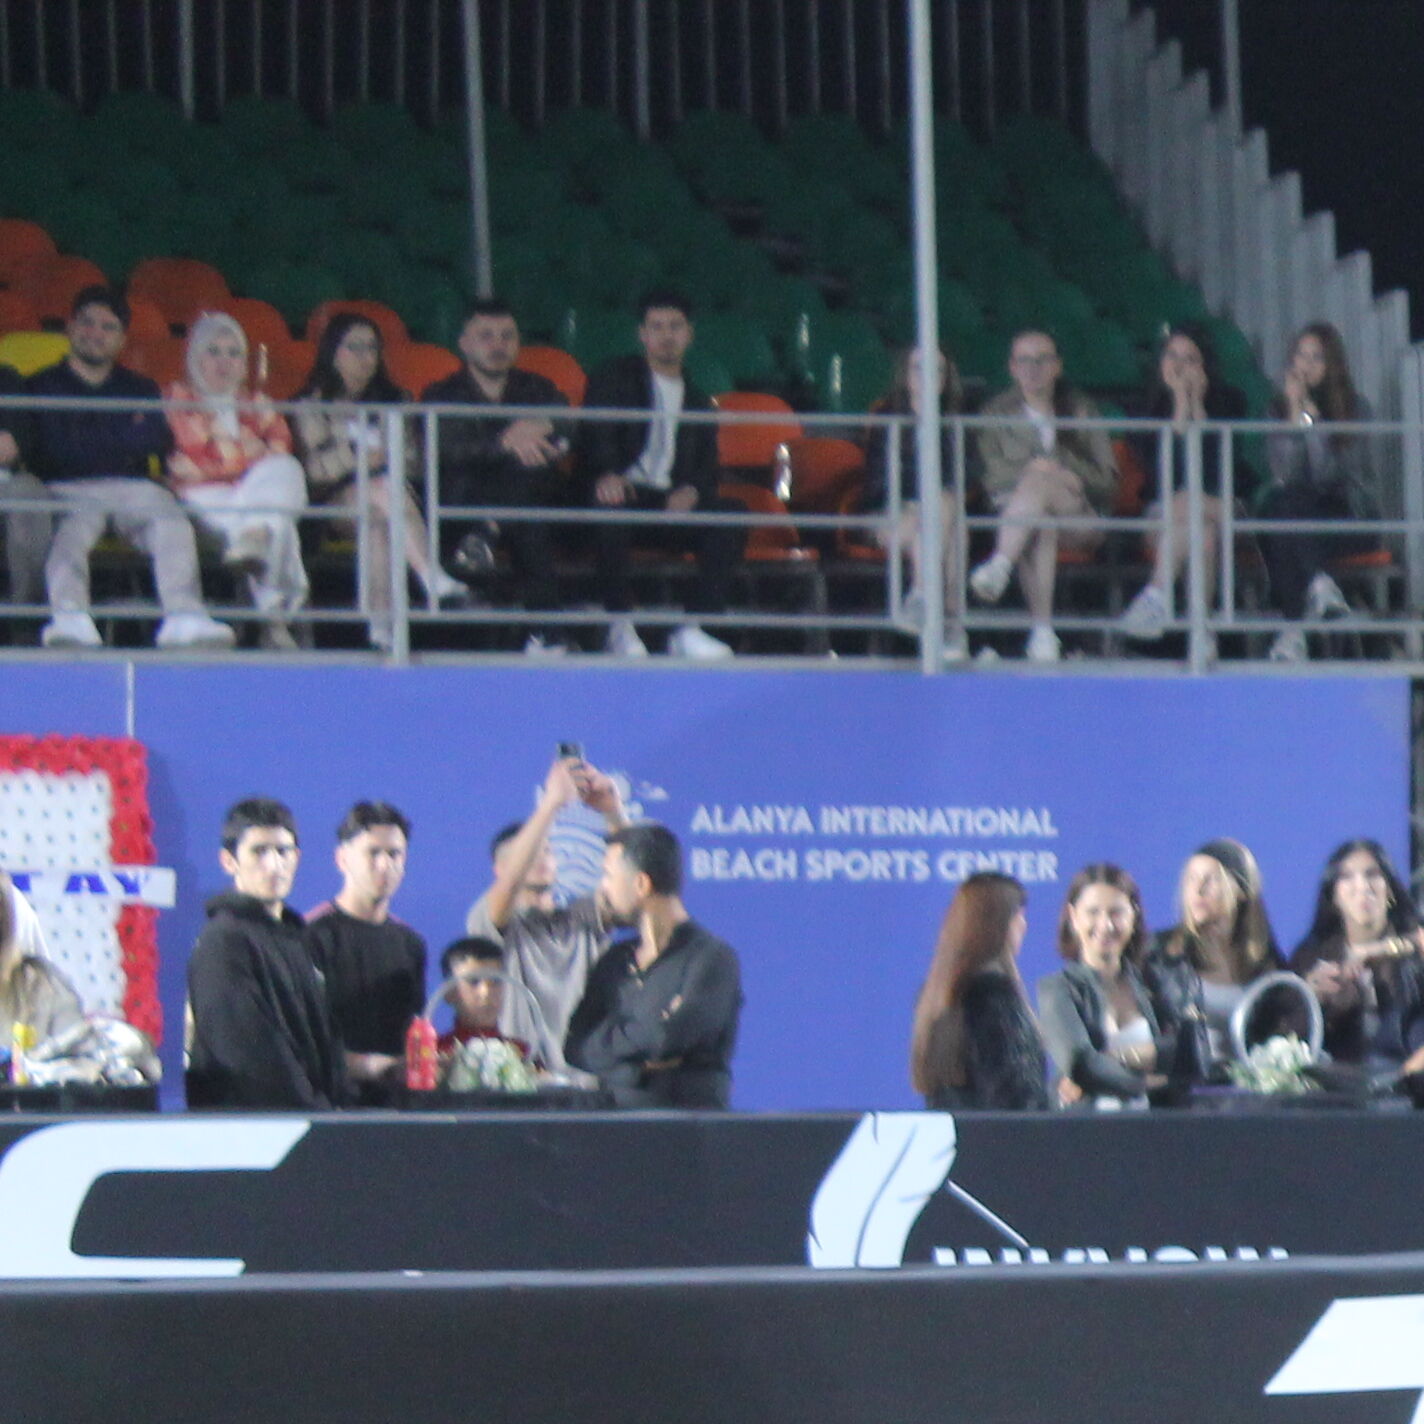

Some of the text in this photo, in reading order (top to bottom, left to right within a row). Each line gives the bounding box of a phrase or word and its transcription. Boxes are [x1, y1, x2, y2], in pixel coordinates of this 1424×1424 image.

[691, 804, 1059, 836] ALANYA INTERNATIONAL
[691, 846, 1059, 881] BEACH SPORTS CENTER
